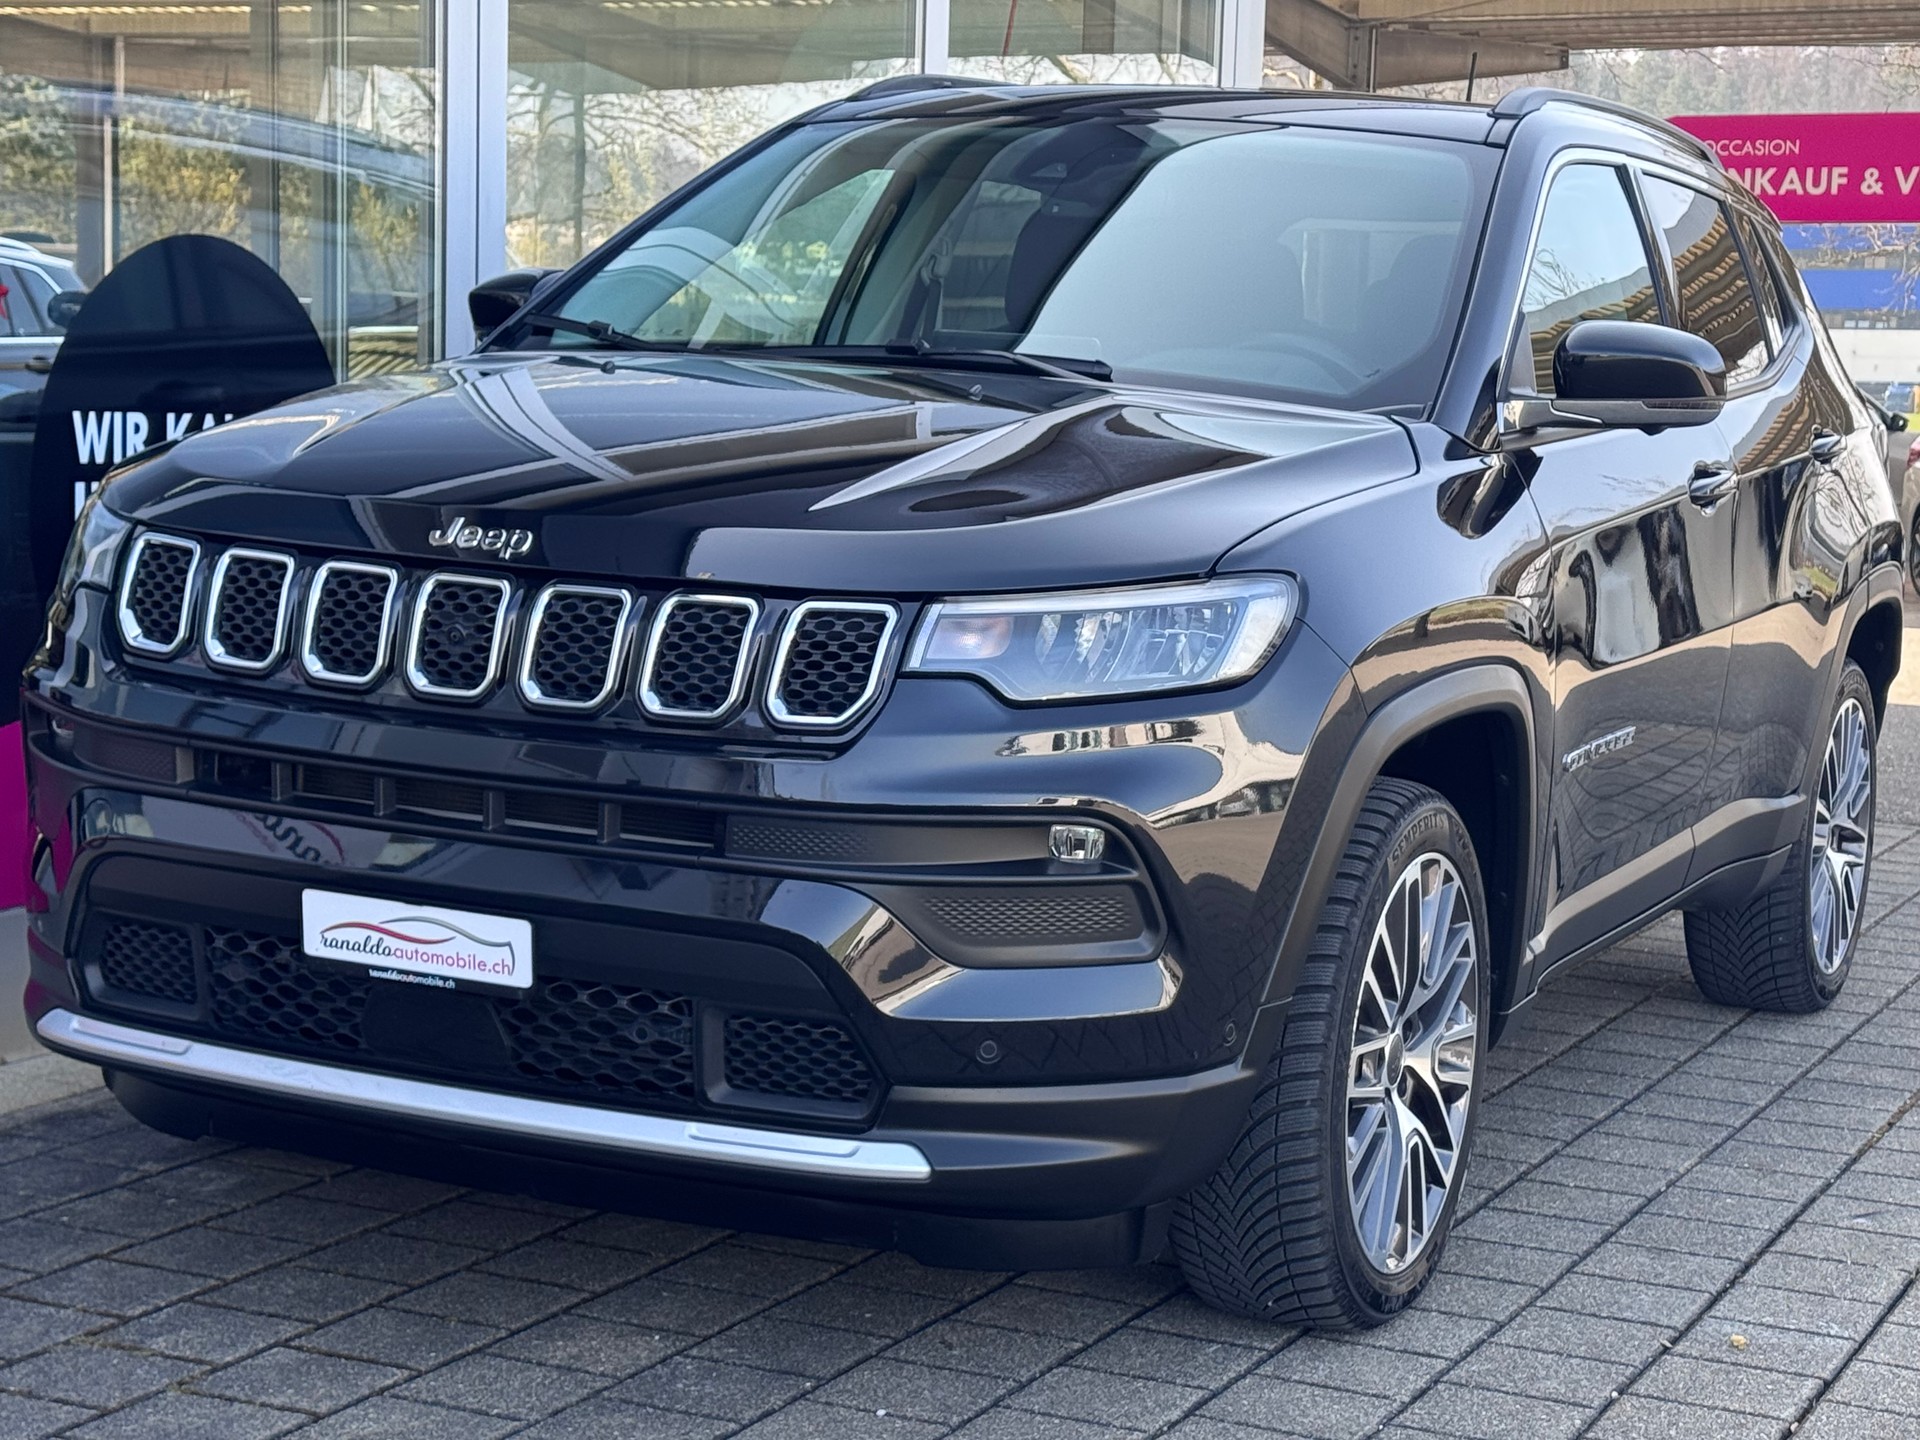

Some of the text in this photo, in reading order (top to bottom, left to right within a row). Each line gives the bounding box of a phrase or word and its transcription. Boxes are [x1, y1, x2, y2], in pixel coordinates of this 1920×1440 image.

[1703, 139, 1800, 156] OCCASION
[1727, 166, 1849, 196] NKAUF
[1860, 168, 1884, 196] &
[72, 410, 149, 465] WIR
[428, 517, 533, 560] Jeep
